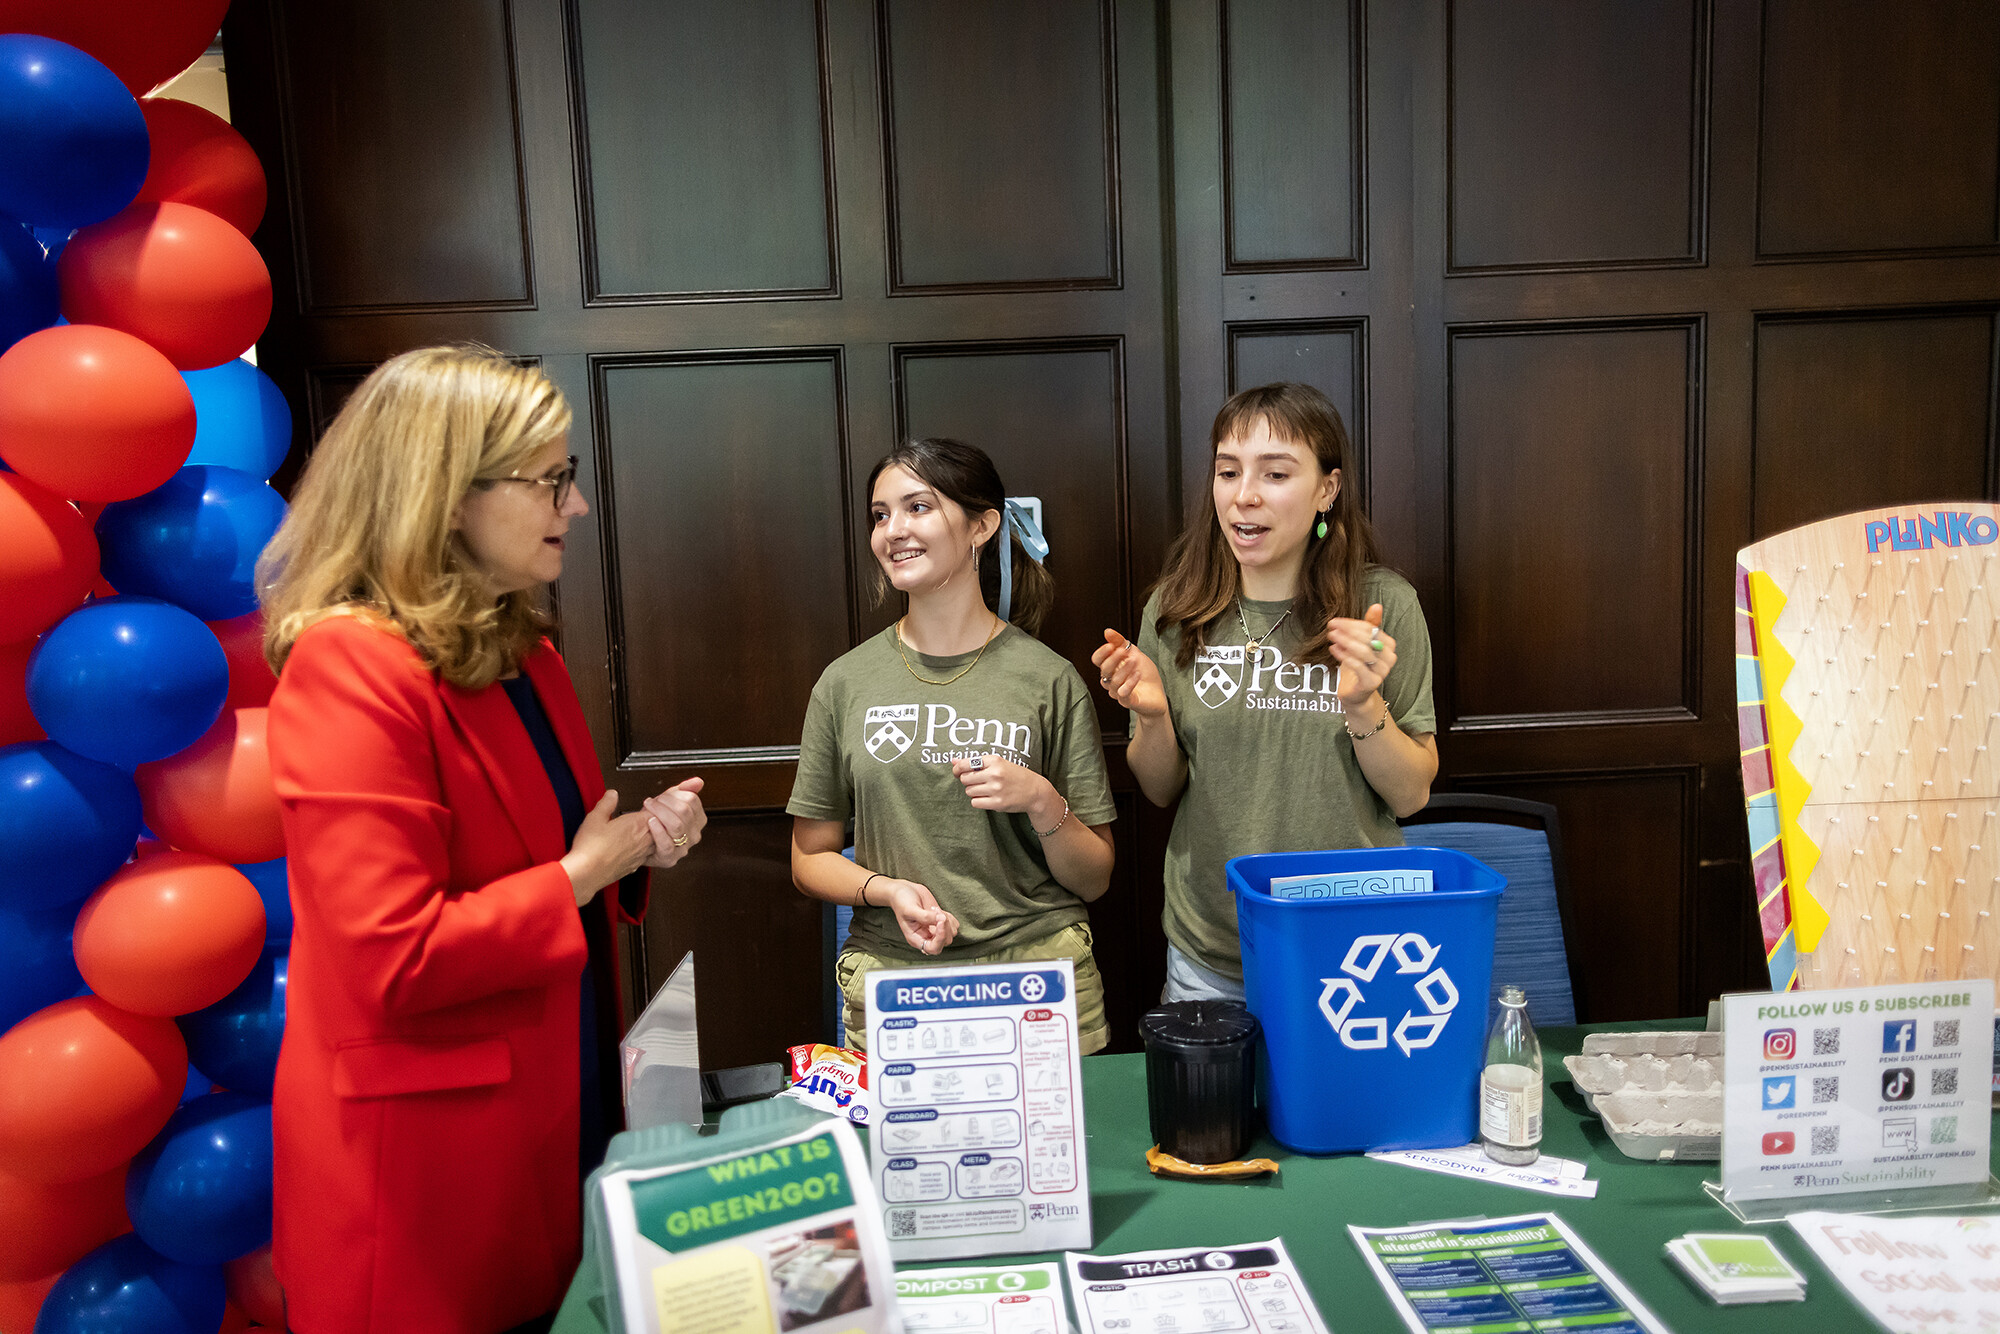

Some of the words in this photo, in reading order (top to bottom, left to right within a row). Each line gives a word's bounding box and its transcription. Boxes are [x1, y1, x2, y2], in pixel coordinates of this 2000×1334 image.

[1865, 512, 1999, 553] PLINKO
[1246, 646, 1342, 695] Pen
[1246, 693, 1346, 714] Sustainabil
[921, 703, 1031, 758] Penn
[897, 982, 1012, 1006] RECYCLING
[1758, 1002, 1828, 1021] FOLLOW
[1833, 1000, 1854, 1014] US
[1859, 999, 1869, 1012] &
[1875, 992, 1972, 1012] SUBSCRIBE
[1901, 1052, 1962, 1062] SUSTAINABILITY
[888, 1066, 912, 1074] PAPER
[1759, 1060, 1846, 1072] @PENNSUSTAINABILITY
[1878, 1100, 1964, 1112] @PENNSUSTAINABILITY
[890, 1112, 935, 1121] CARDBOARD
[1777, 1110, 1828, 1120] @GREENPENN
[1887, 1130, 1912, 1138] WWW
[707, 1146, 792, 1184] WHAT
[798, 1138, 831, 1163] IS
[964, 1156, 988, 1164] METAL
[1403, 1152, 1490, 1174] SENSODYNE
[1873, 1150, 1976, 1163] SUSTAINABILITY.UPENN.EDU
[1760, 1164, 1780, 1172] PENN
[1782, 1160, 1843, 1170] SUSTAINABILITY
[1806, 1173, 1840, 1187] Penn
[1841, 1165, 1936, 1185] Sustainability
[665, 1172, 840, 1236] GREEN2GO?
[1046, 1202, 1079, 1217] Penn
[1378, 1238, 1445, 1252] Interested
[1459, 1228, 1549, 1247] Sustainability?
[1398, 1230, 1437, 1240] STUDENTS!
[1820, 1225, 1948, 1260] Follow
[1122, 1259, 1197, 1277] TRASH
[896, 1277, 988, 1293] OMPOST
